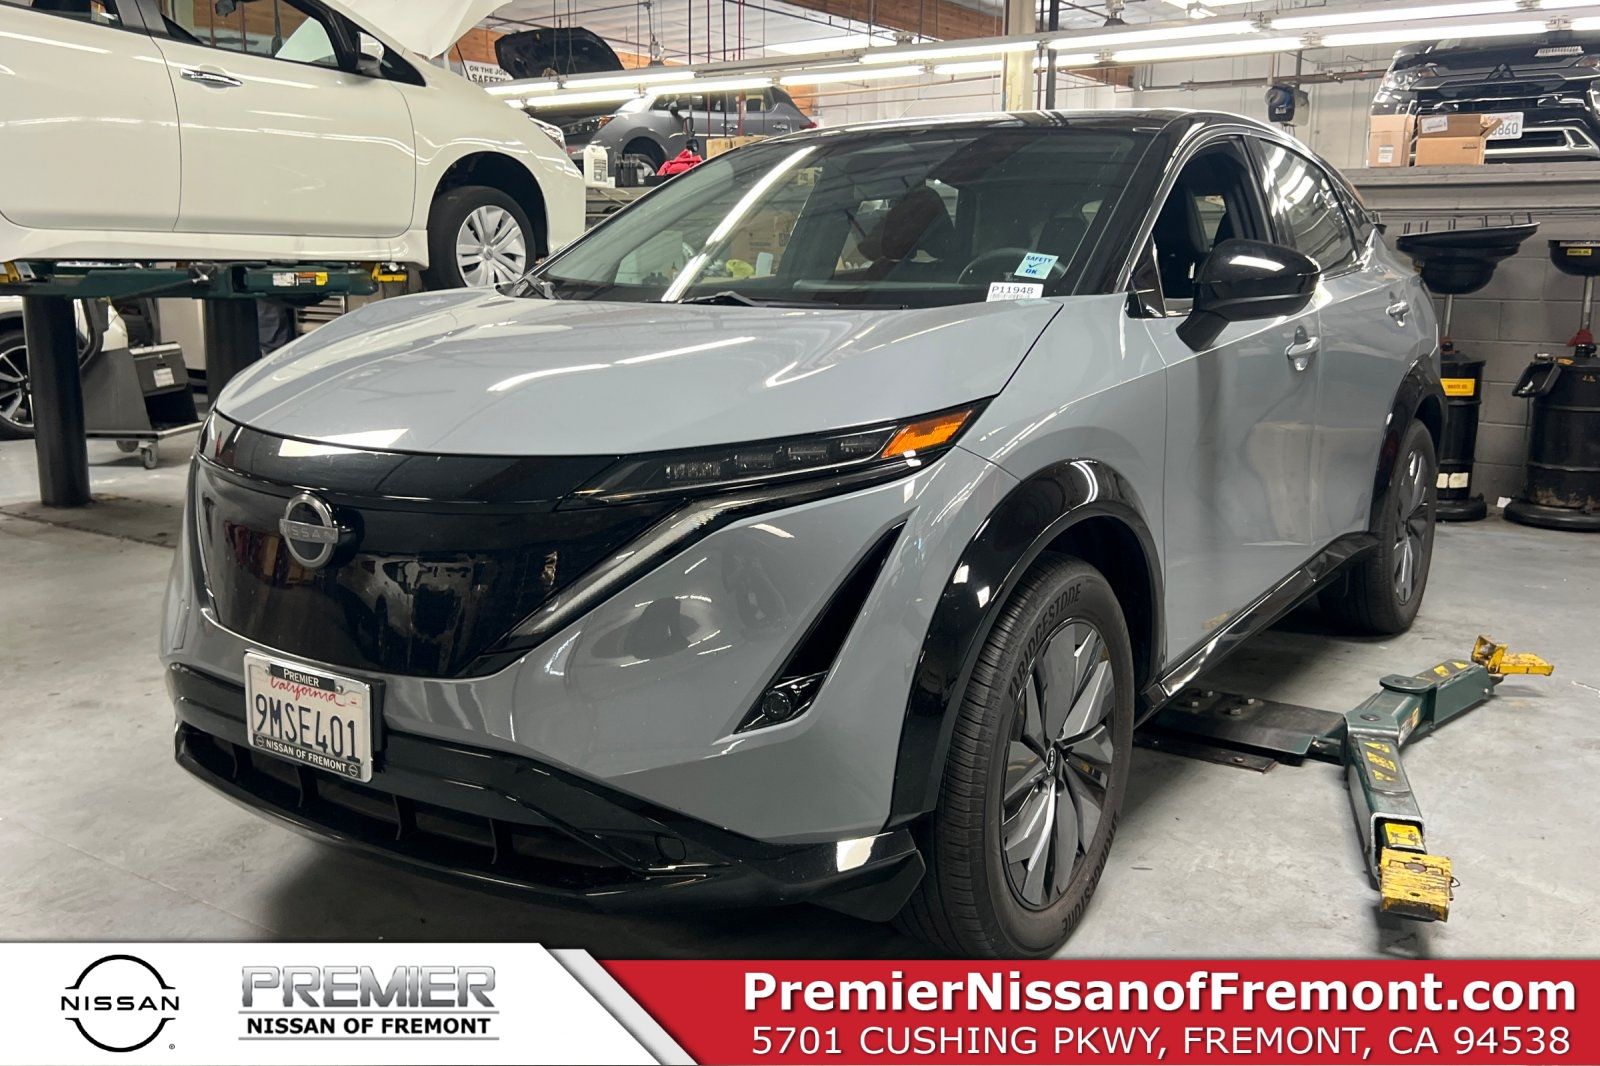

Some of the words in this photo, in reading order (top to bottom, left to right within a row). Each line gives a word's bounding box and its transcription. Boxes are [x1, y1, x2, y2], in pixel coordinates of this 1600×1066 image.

[481, 66, 493, 74] THE
[1491, 122, 1518, 136] 860
[992, 286, 1034, 294] P11948
[1008, 583, 1081, 702] BRIDGESTONE
[283, 668, 320, 688] PREMIER
[255, 693, 361, 764] 9MSE401
[266, 739, 295, 756] NISSAN
[296, 750, 307, 759] OF
[308, 754, 347, 772] FREMONT
